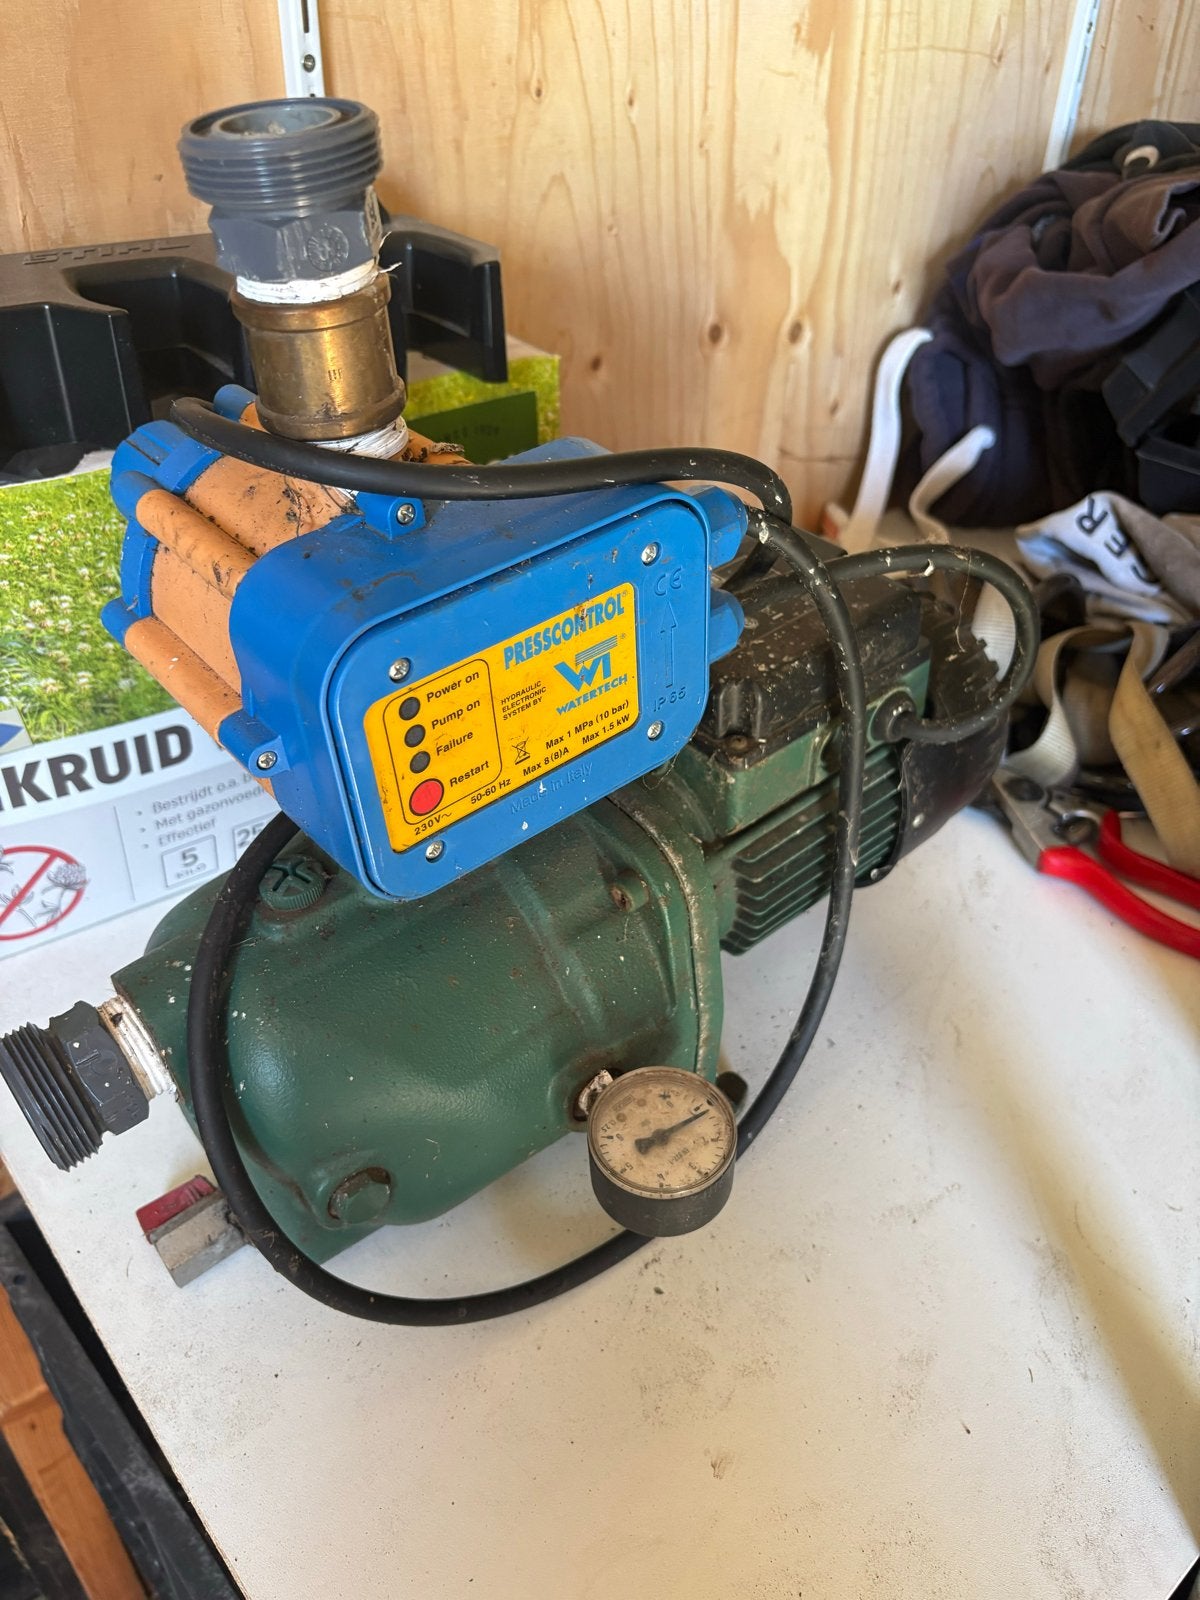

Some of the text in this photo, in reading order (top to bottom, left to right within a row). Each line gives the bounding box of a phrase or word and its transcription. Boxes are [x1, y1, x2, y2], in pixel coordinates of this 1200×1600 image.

[23, 240, 190, 265] STIHL
[504, 593, 625, 670] PRESSCONTROL
[426, 672, 479, 702] Power on
[501, 681, 541, 705] HYDRAULIC
[502, 687, 547, 713] ELECTRONIC
[556, 674, 628, 715] WATERTECH
[431, 700, 480, 729] Pump on
[503, 697, 542, 720] SYSTEM BY
[545, 735, 564, 749] Max
[575, 720, 594, 734] MPa
[596, 711, 609, 723] (10
[612, 700, 629, 715] bar)
[582, 714, 630, 744] Max 1.5 kW
[436, 732, 473, 756] Failure
[0, 724, 193, 812] KRUID
[449, 760, 489, 787] Restart
[523, 762, 541, 776] Max
[152, 781, 213, 814] Bestrijdt
[471, 779, 511, 805] 50-60 Hz
[510, 787, 548, 815] Made
[567, 762, 593, 784] Italy
[155, 815, 182, 830] Met
[159, 818, 216, 846] Effectief
[181, 847, 198, 867] 5
